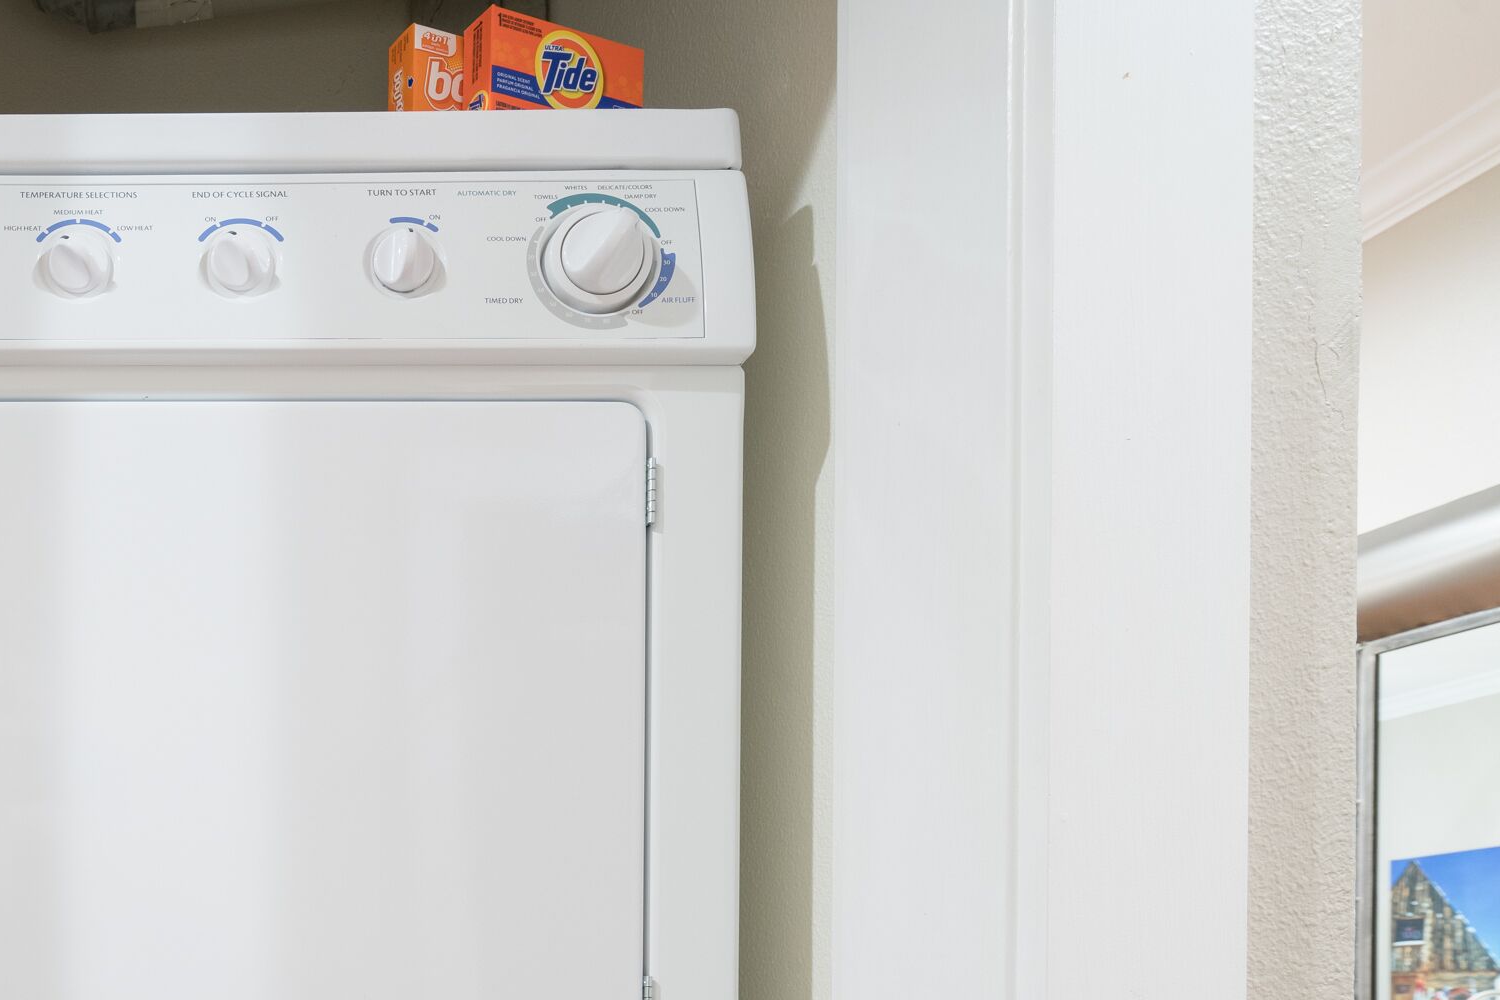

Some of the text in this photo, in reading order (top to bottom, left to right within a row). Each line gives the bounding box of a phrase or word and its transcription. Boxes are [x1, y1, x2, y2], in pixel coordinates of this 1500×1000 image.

[496, 71, 517, 81] ORIGINAL
[541, 51, 598, 95] Tide
[514, 82, 534, 91] ORIGINAL
[20, 191, 138, 199] TEMPERATURE SELECTIONS
[192, 191, 211, 199] END
[255, 190, 288, 198] SIGNAL
[367, 189, 393, 197] TURN
[409, 188, 436, 196] START
